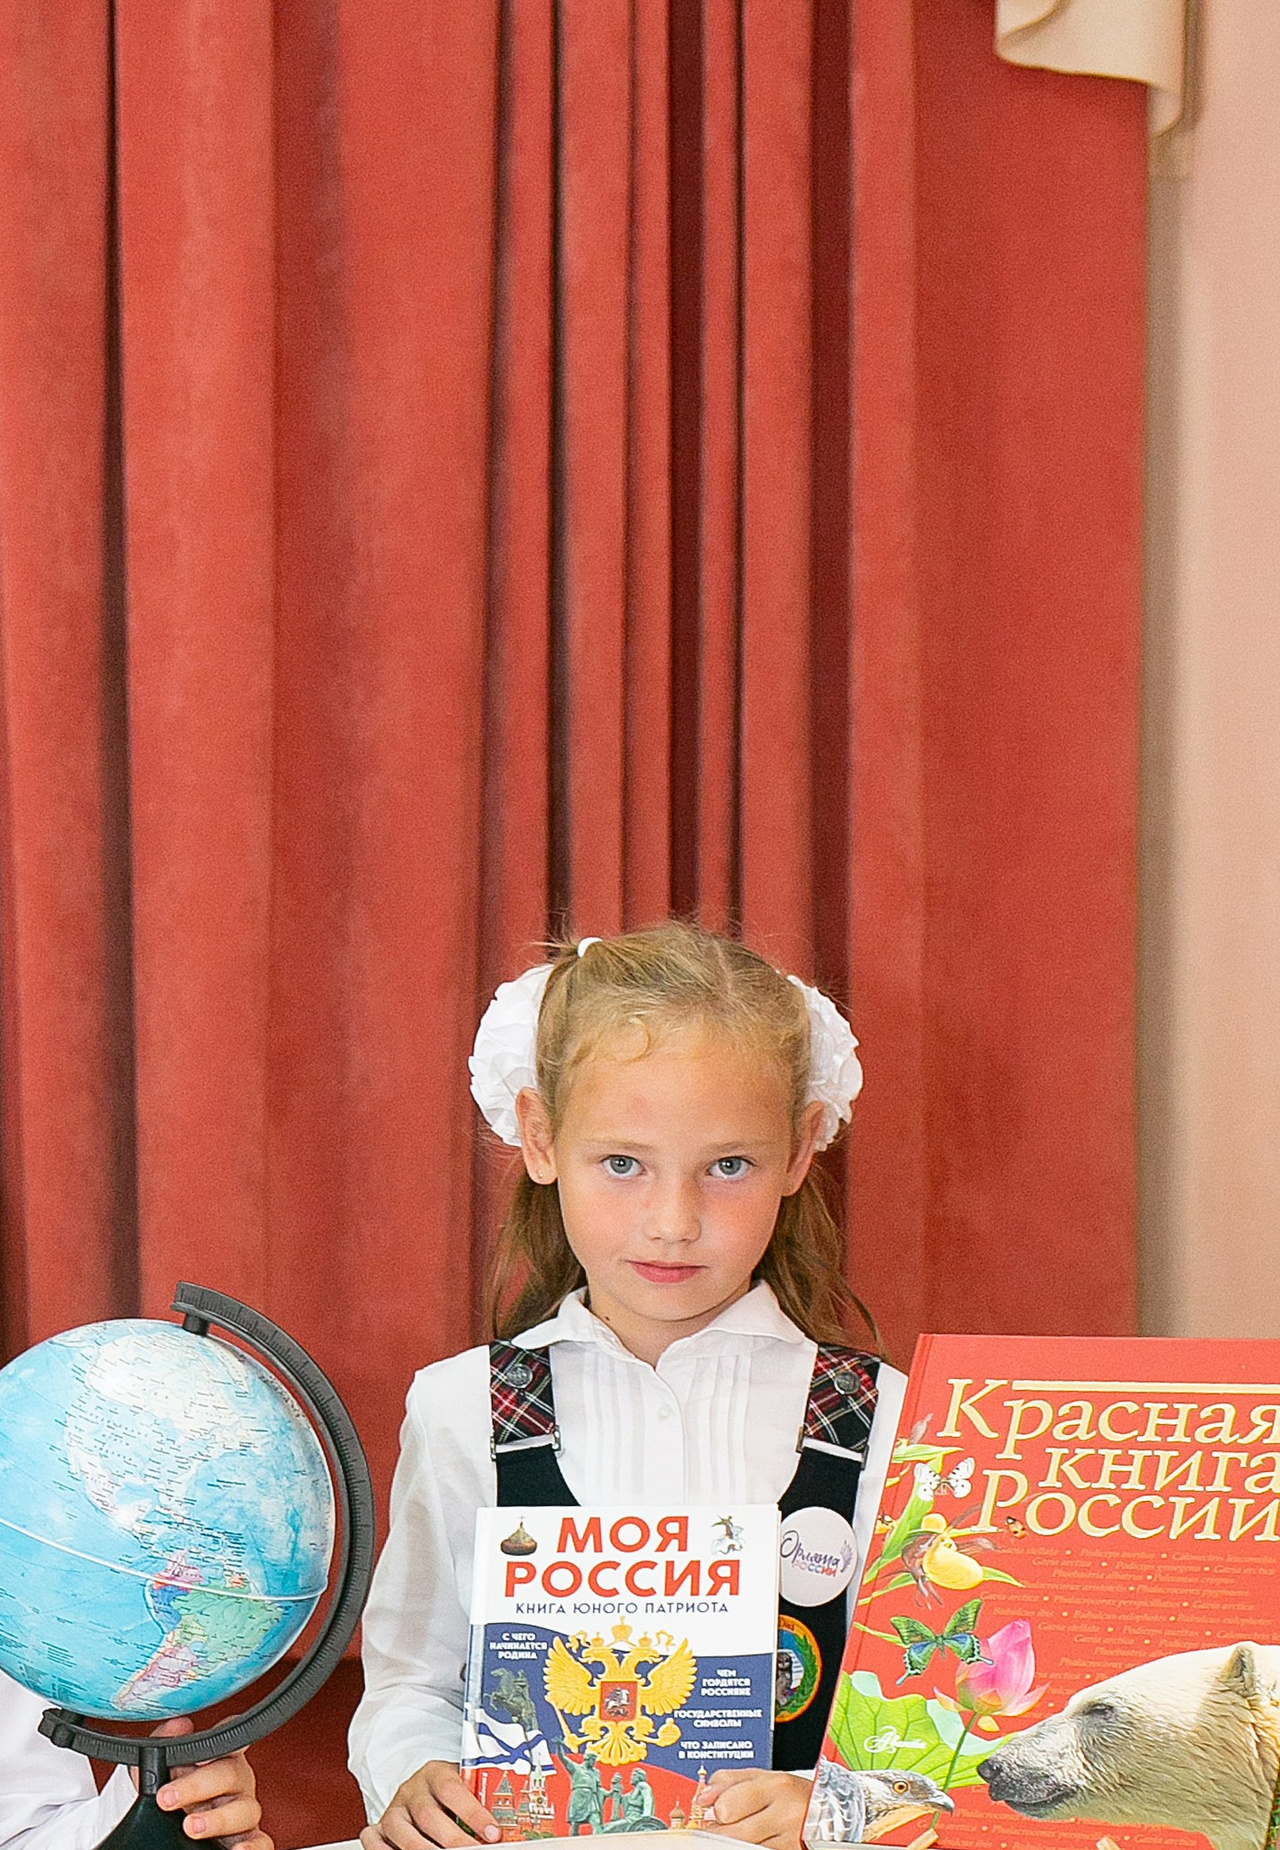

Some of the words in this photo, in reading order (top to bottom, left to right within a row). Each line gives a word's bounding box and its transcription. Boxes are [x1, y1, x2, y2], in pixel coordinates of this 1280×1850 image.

[936, 1378, 1280, 1461] Красная
[1038, 1448, 1280, 1494] книга
[970, 1469, 1280, 1542] России
[556, 1515, 689, 1554] МОЯ
[504, 1559, 741, 1598] РОССИЯ
[515, 1602, 567, 1614] КНИГА
[573, 1602, 639, 1615] ЮНОГО
[645, 1601, 730, 1614] ПАТРИОТА
[502, 1633, 511, 1641] С
[512, 1633, 536, 1641] ЧЕГО
[489, 1642, 548, 1651] НАЧИНАЕТСЯ
[498, 1651, 538, 1660] РОДИНА
[717, 1669, 737, 1678] ЧЕМ
[702, 1678, 752, 1688] ГОРДЯТСЯ
[673, 1709, 763, 1719] ГОСУДАРСТВЕННЫЕ
[693, 1719, 742, 1728] СИМВОЛЫ
[680, 1741, 701, 1750] ЧТО
[701, 1741, 753, 1750] ЗАПИСАНО
[678, 1750, 686, 1759] В
[687, 1750, 755, 1760] КОНСТИТУЦИИ
